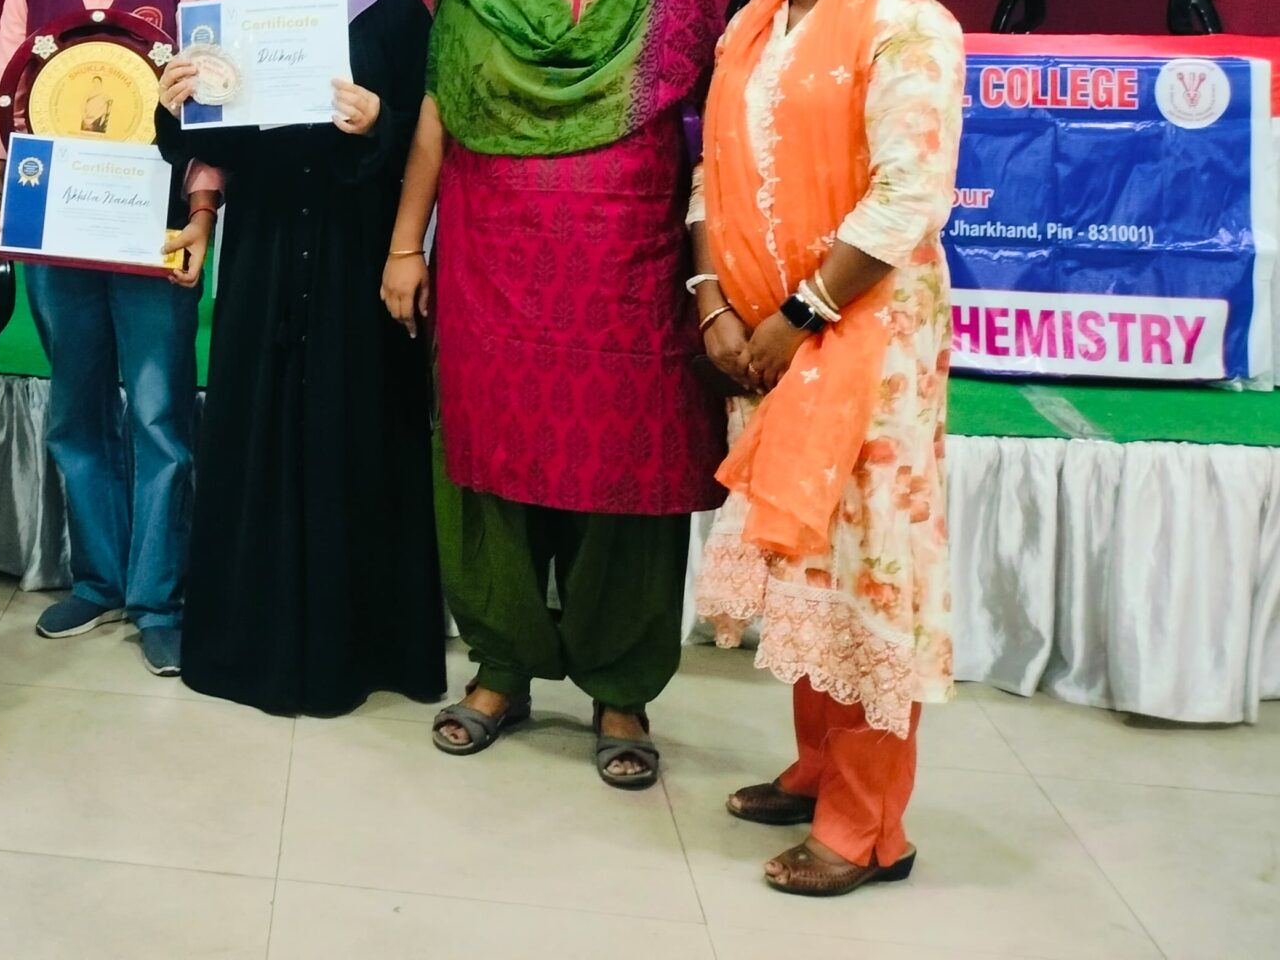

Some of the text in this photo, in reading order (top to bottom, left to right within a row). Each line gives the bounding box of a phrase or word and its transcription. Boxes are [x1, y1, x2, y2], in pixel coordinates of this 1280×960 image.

[241, 16, 321, 31] Certificate
[980, 65, 1139, 110] COLLEGE
[72, 160, 145, 177] Certificate
[949, 220, 1042, 241] Jharkhand,
[1046, 223, 1073, 240] Pin
[1088, 224, 1154, 245] 831001)
[951, 305, 1206, 364] HEMISTRY
